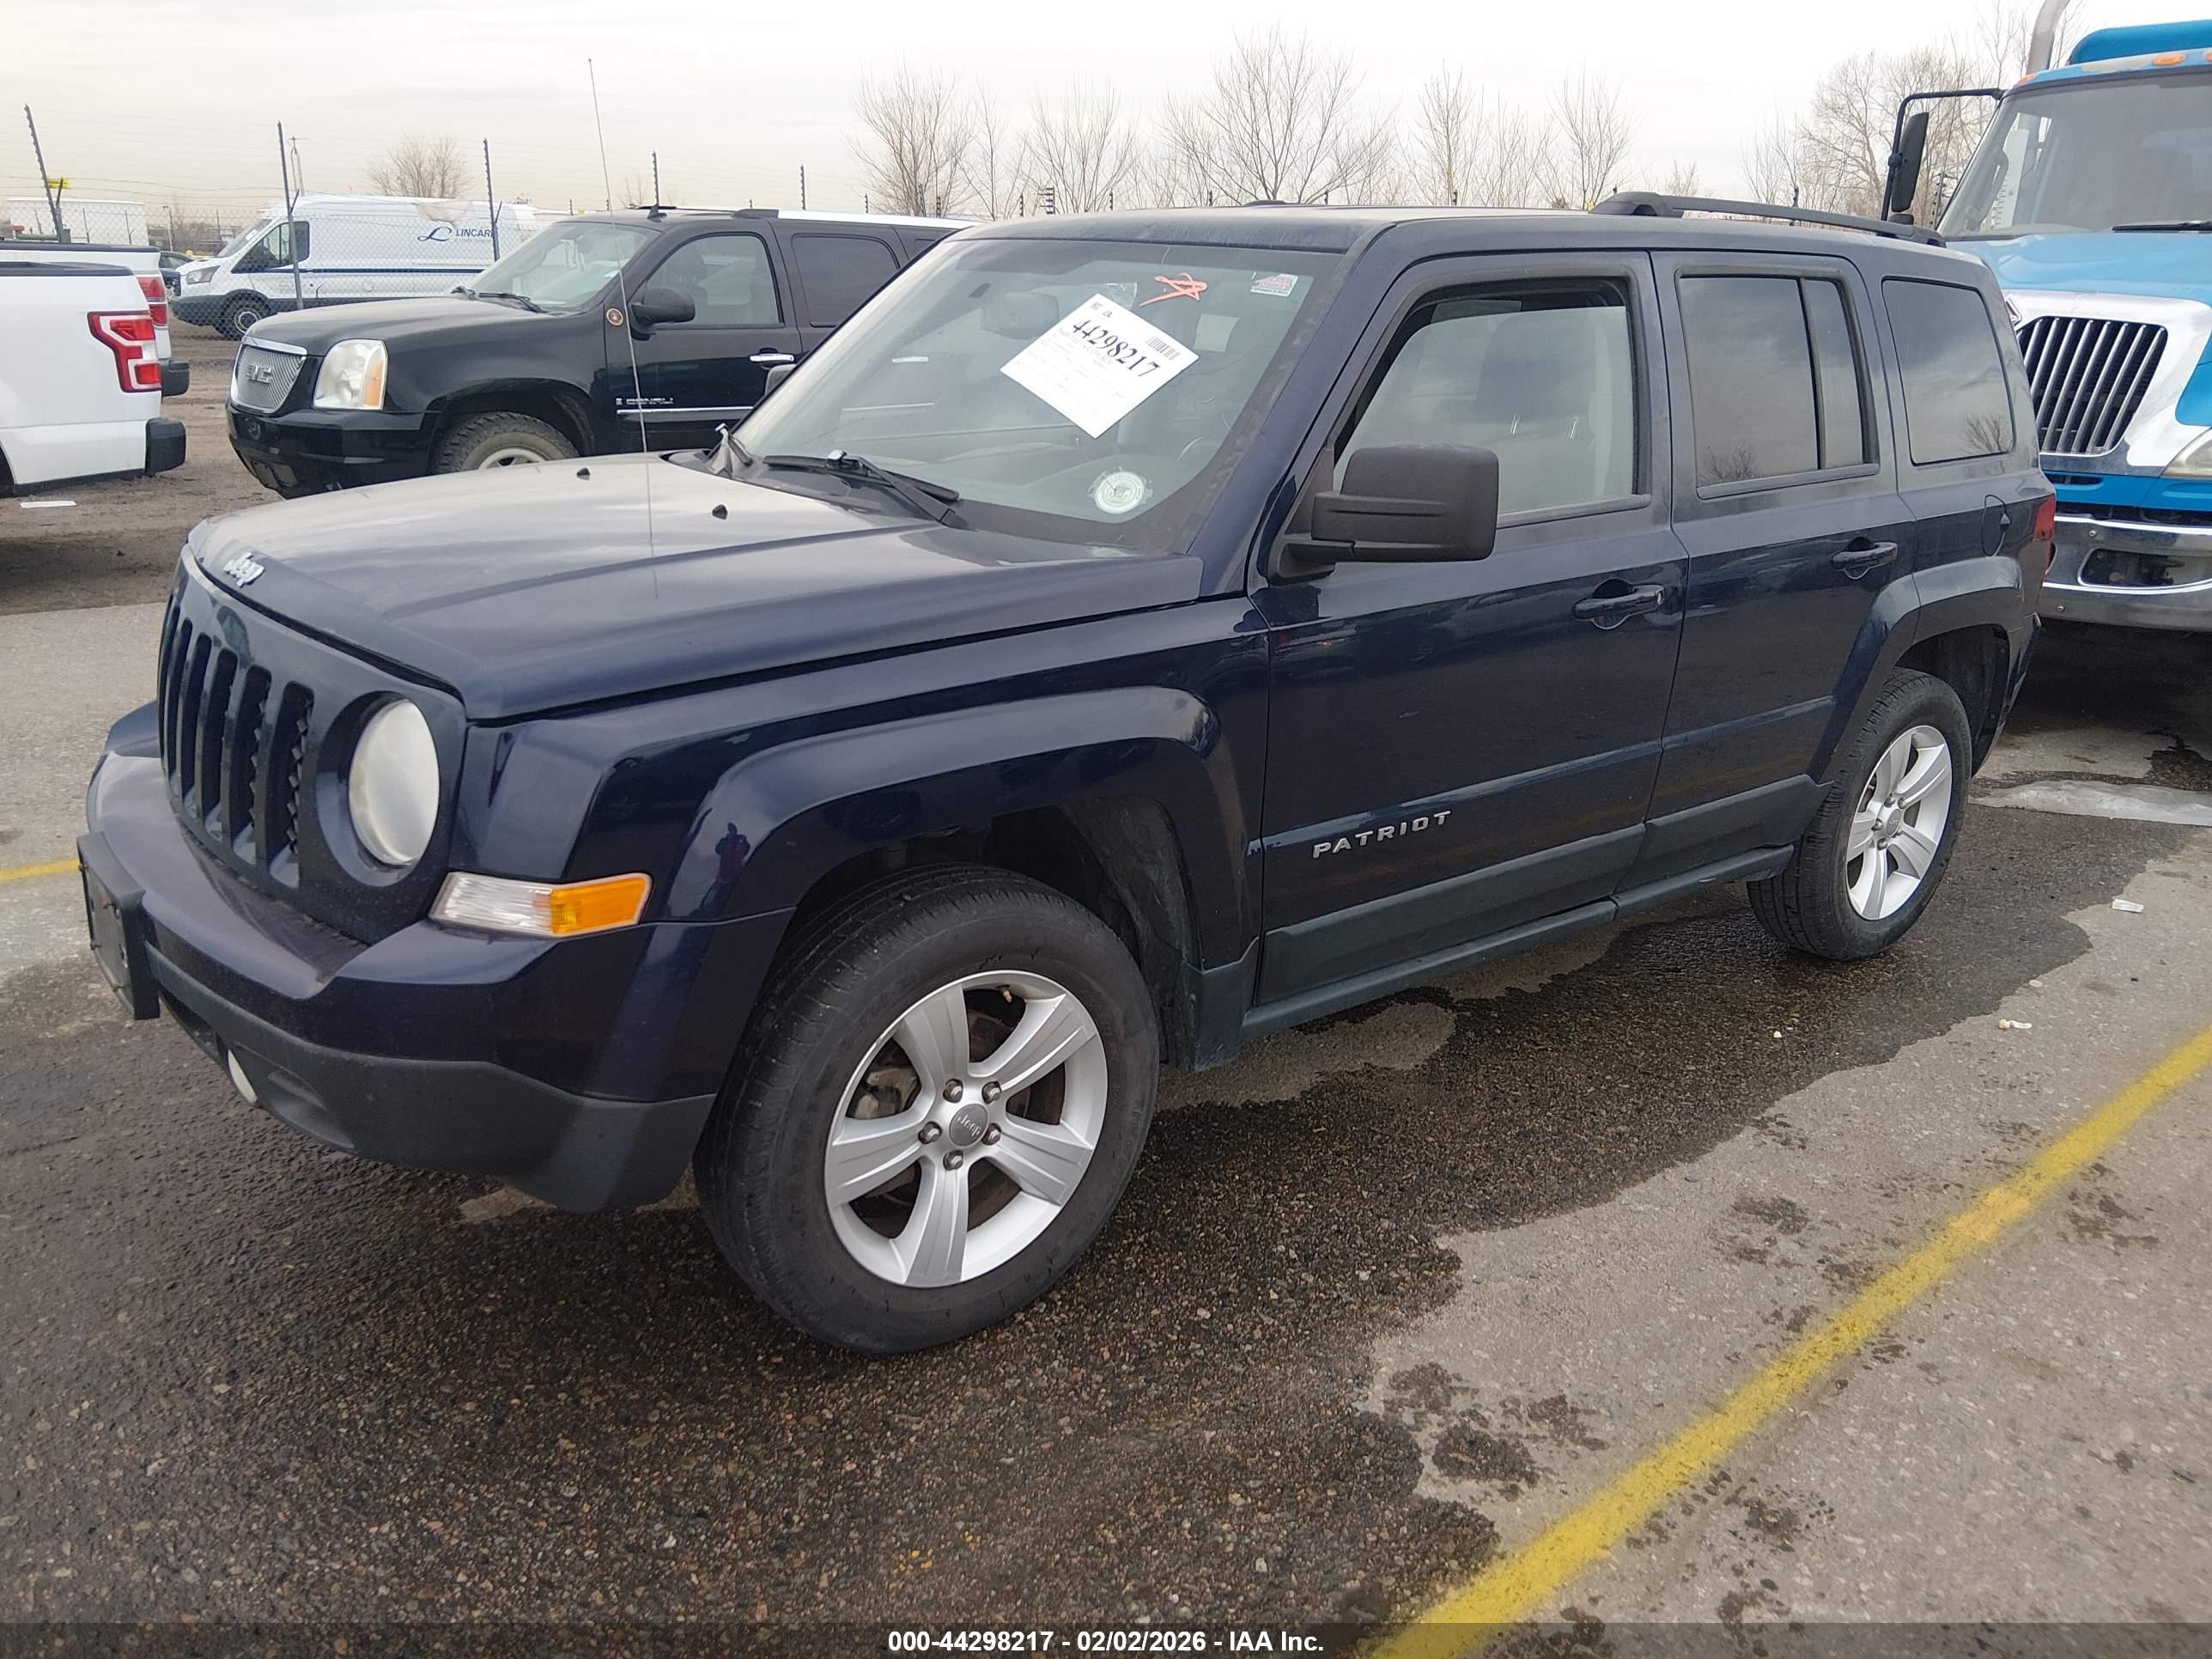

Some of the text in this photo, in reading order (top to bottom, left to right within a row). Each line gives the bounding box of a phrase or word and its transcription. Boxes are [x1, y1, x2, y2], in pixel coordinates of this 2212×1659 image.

[1073, 319, 1161, 377] 44298217
[1312, 811, 1451, 859] PATRIOT
[957, 1114, 981, 1139] Jeep
